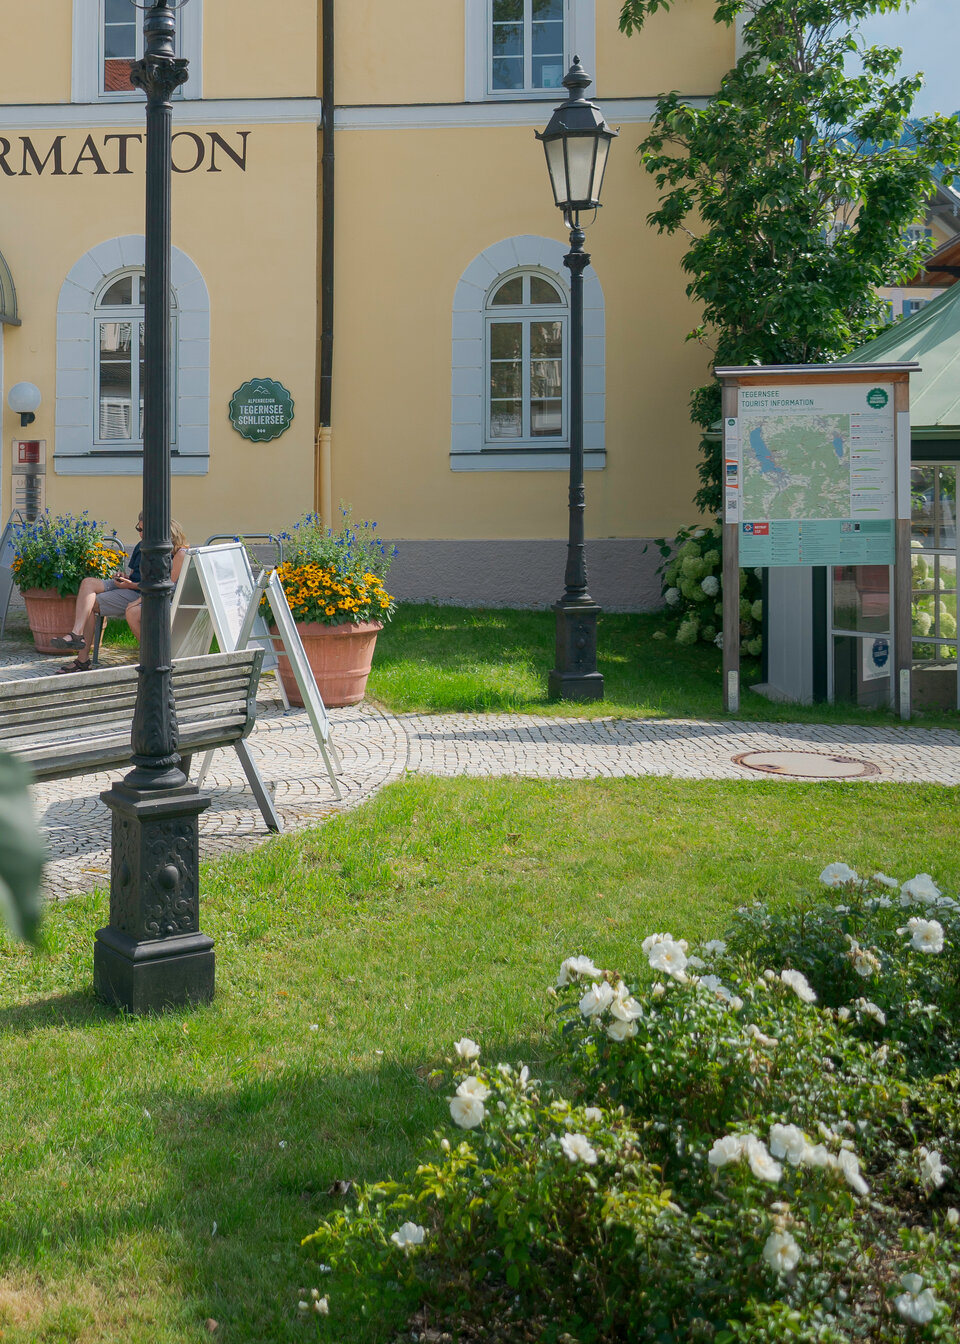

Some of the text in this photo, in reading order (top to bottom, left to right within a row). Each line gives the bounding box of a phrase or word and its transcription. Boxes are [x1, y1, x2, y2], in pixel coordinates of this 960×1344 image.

[741, 390, 780, 398] TEGERNSEE
[741, 399, 814, 407] TOURIST INFORMATION
[240, 405, 283, 414] TEGERNSEE
[238, 415, 285, 425] SCHLIERSEE
